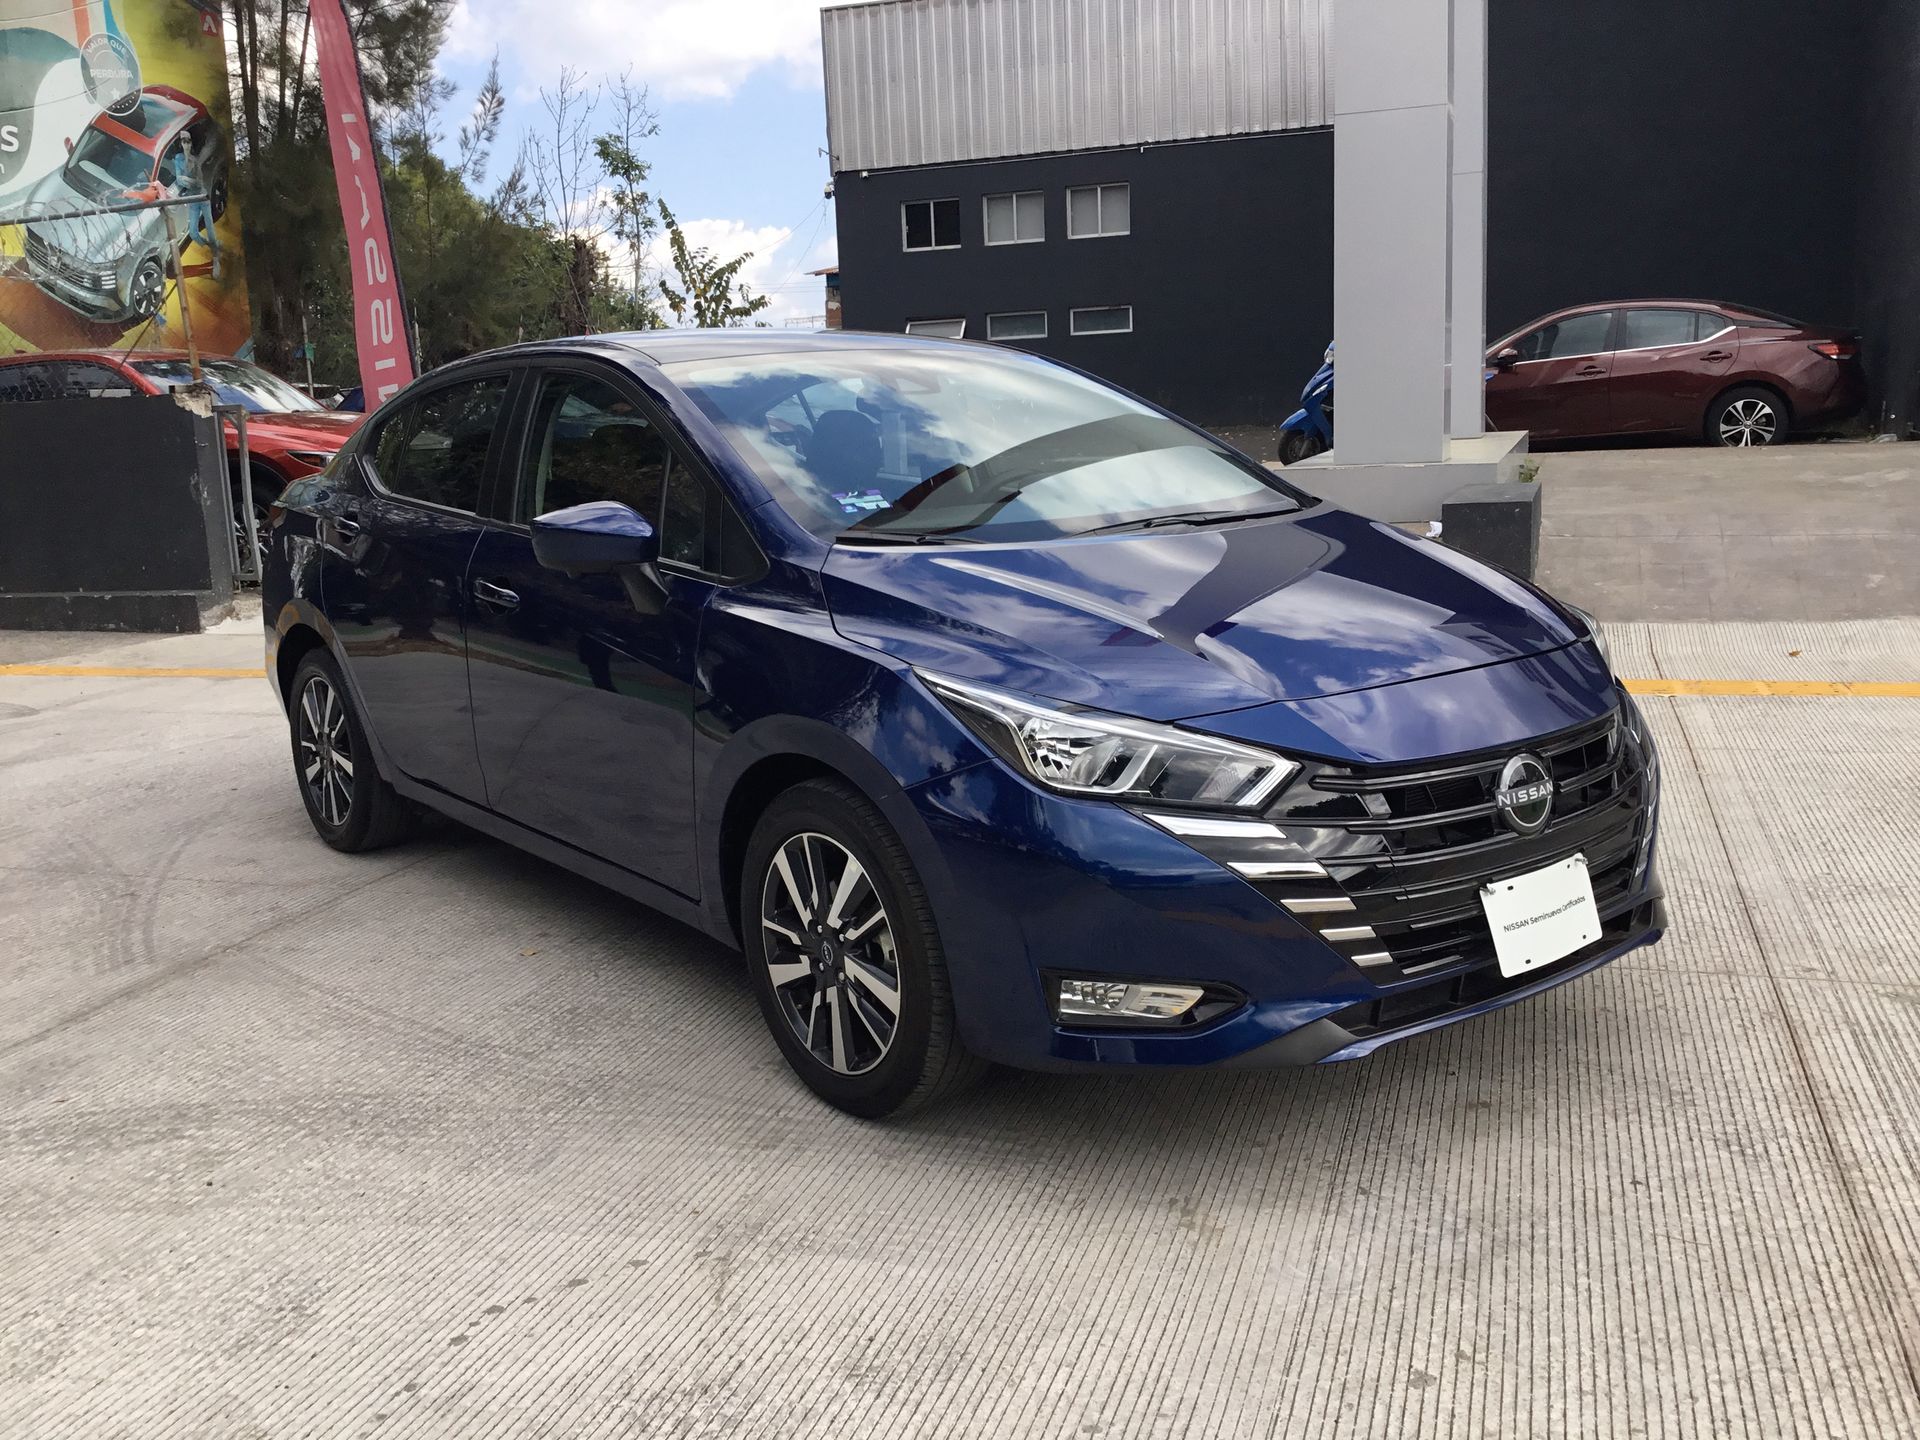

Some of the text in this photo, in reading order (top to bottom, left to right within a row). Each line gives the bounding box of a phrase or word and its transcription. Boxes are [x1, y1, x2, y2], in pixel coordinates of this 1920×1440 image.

[110, 39, 127, 56] QUE
[90, 68, 134, 79] PERDURA
[1497, 779, 1554, 807] NISSAN
[1503, 895, 1586, 933] NISSAN Seminuevos Certificados
